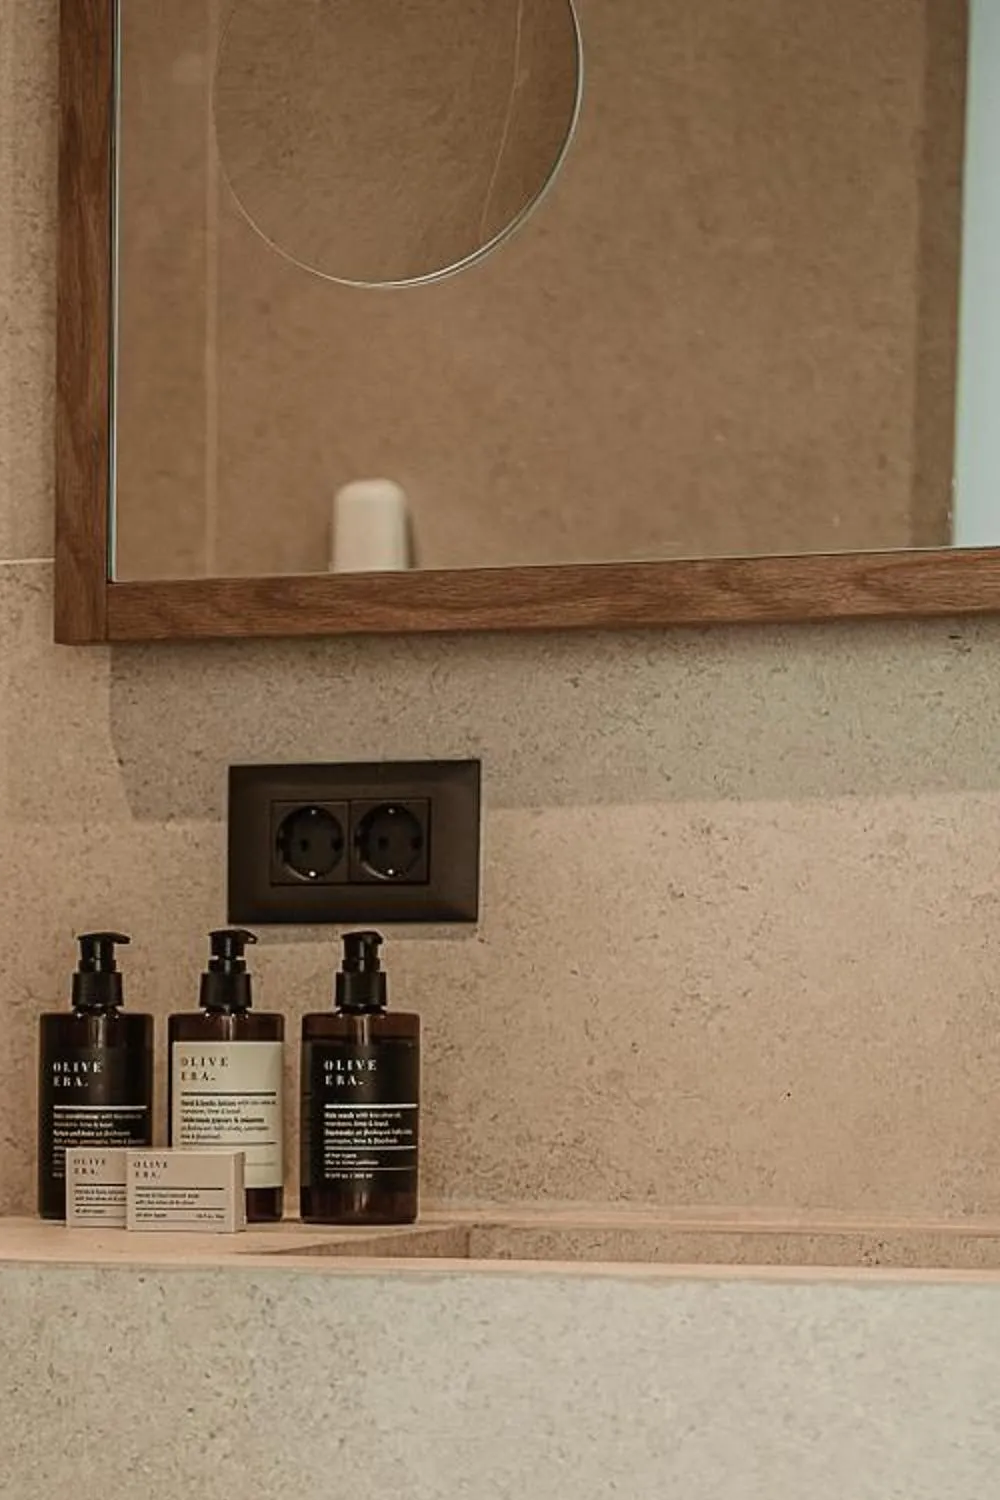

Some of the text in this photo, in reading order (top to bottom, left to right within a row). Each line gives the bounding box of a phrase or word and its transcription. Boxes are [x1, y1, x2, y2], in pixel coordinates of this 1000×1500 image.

[53, 1061, 103, 1073] OLIVE
[181, 1056, 229, 1068] OLIVE
[323, 1059, 378, 1071] OLIVE
[53, 1076, 89, 1087] ERA.
[324, 1074, 365, 1086] ERA.
